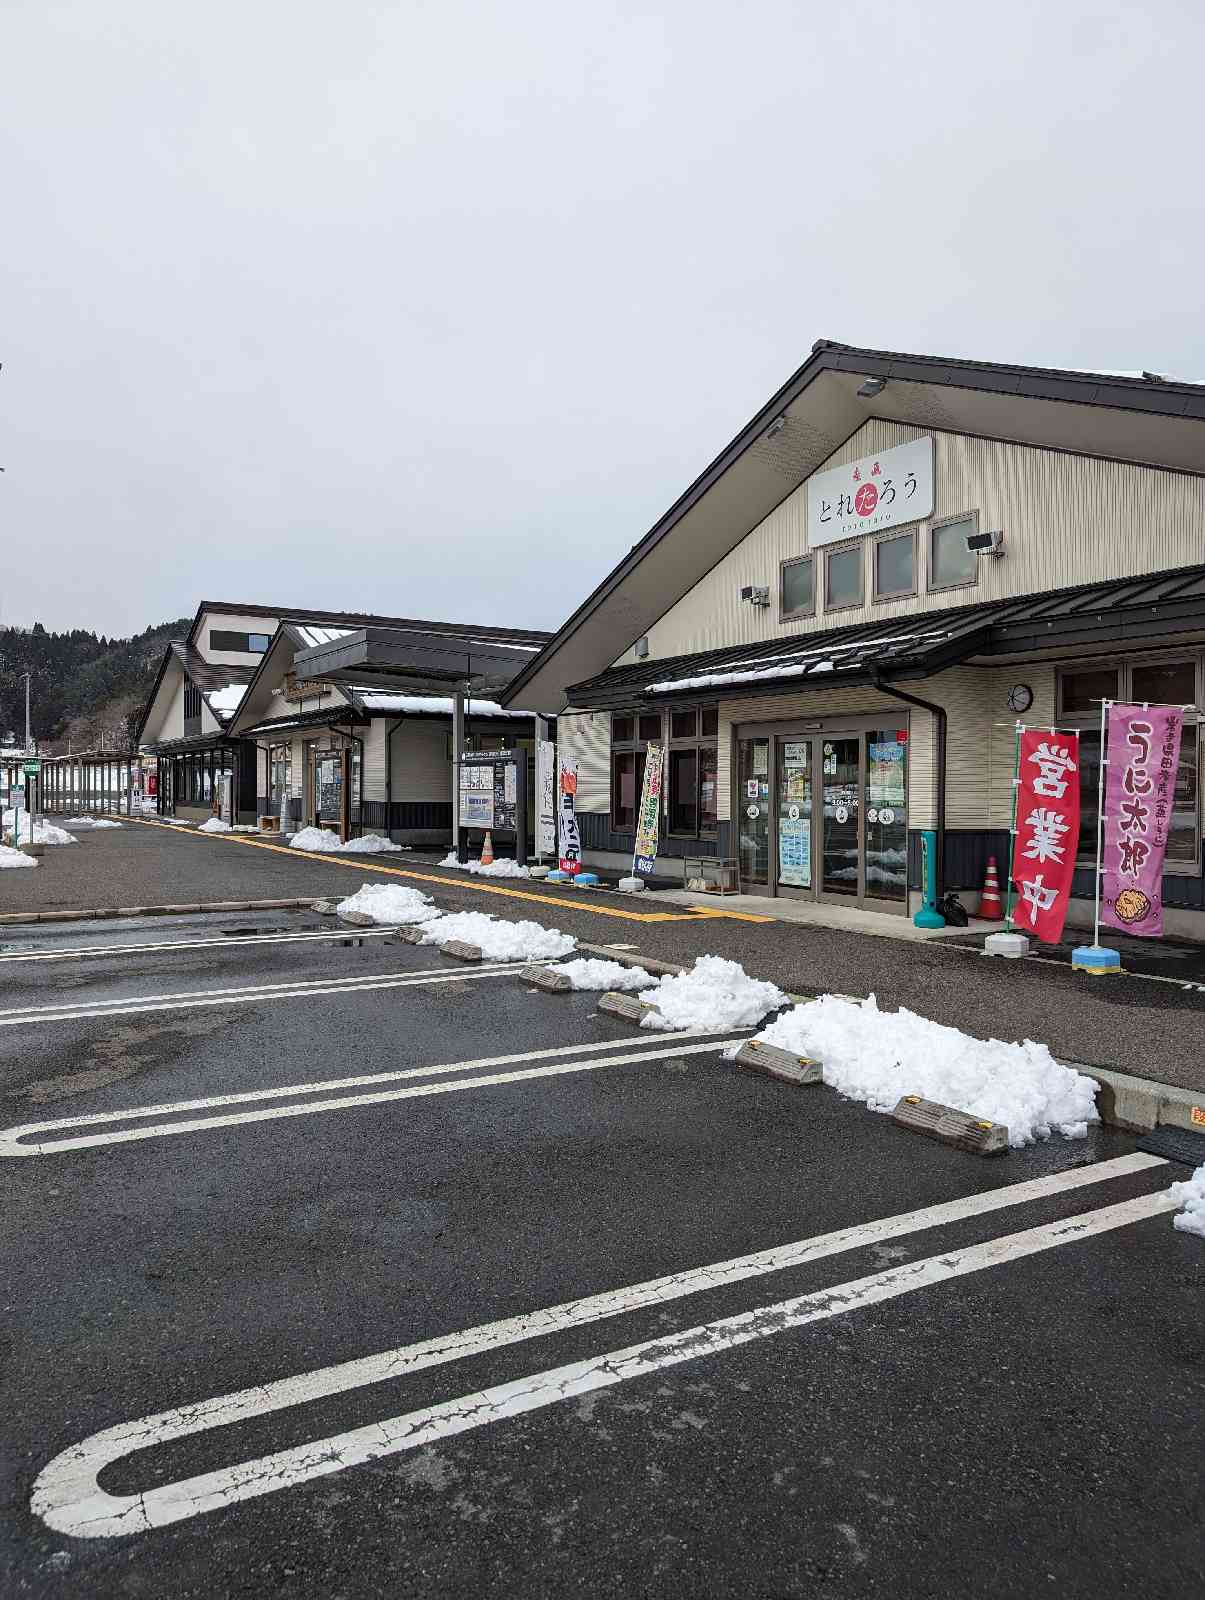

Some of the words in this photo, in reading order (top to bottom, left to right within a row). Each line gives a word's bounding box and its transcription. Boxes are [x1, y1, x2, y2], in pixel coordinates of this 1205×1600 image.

[819, 470, 918, 523] とれたろう
[1021, 742, 1077, 926] 営業中
